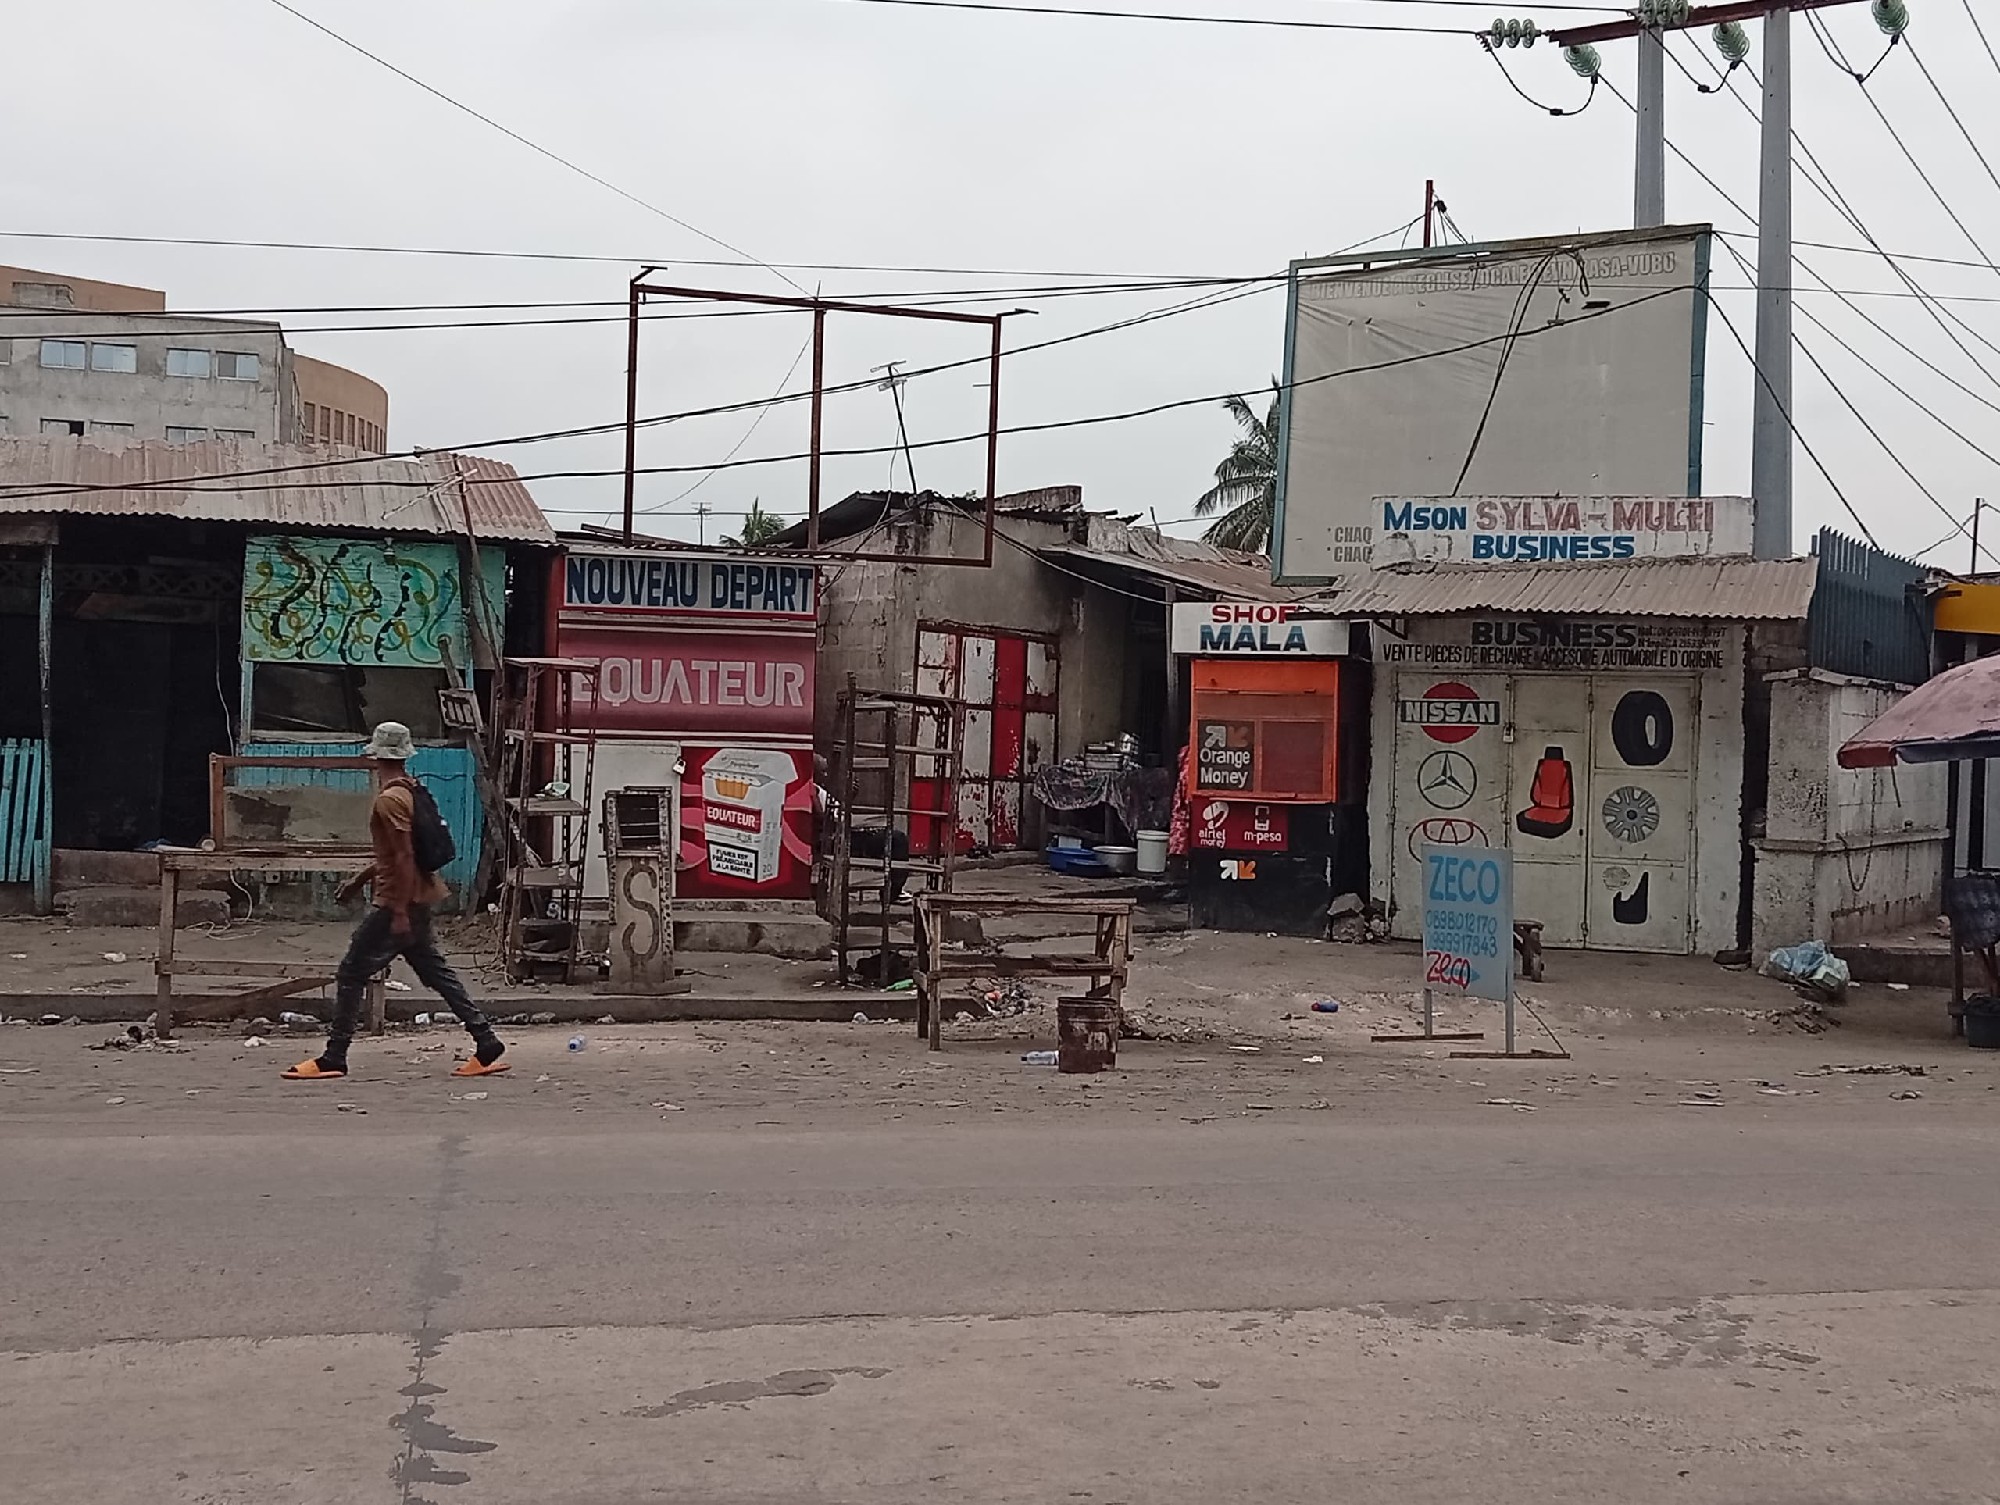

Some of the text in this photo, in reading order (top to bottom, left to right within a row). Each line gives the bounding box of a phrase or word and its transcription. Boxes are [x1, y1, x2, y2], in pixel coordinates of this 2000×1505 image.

[1476, 500, 1581, 531] SYLVA
[1473, 535, 1635, 559] BUSINESS
[567, 557, 814, 612] NOUVEAU DEPART
[1200, 624, 1308, 652] MALA
[1472, 621, 1637, 648] BUSINESS
[1383, 643, 1422, 662] VENTE
[1425, 644, 1462, 663] PIECES
[1464, 646, 1478, 664] DE
[1601, 648, 1667, 667] AUTOMOBILE
[1670, 649, 1724, 669] D'ORIGINE
[571, 655, 805, 708] EQUATEUR
[1404, 701, 1497, 724] NISSAN
[1200, 749, 1251, 768] Orange
[1200, 767, 1249, 788] Money
[706, 806, 757, 828] EQUATEUR
[1199, 829, 1282, 844] airtel m-pesa
[1429, 855, 1500, 905] ZECO
